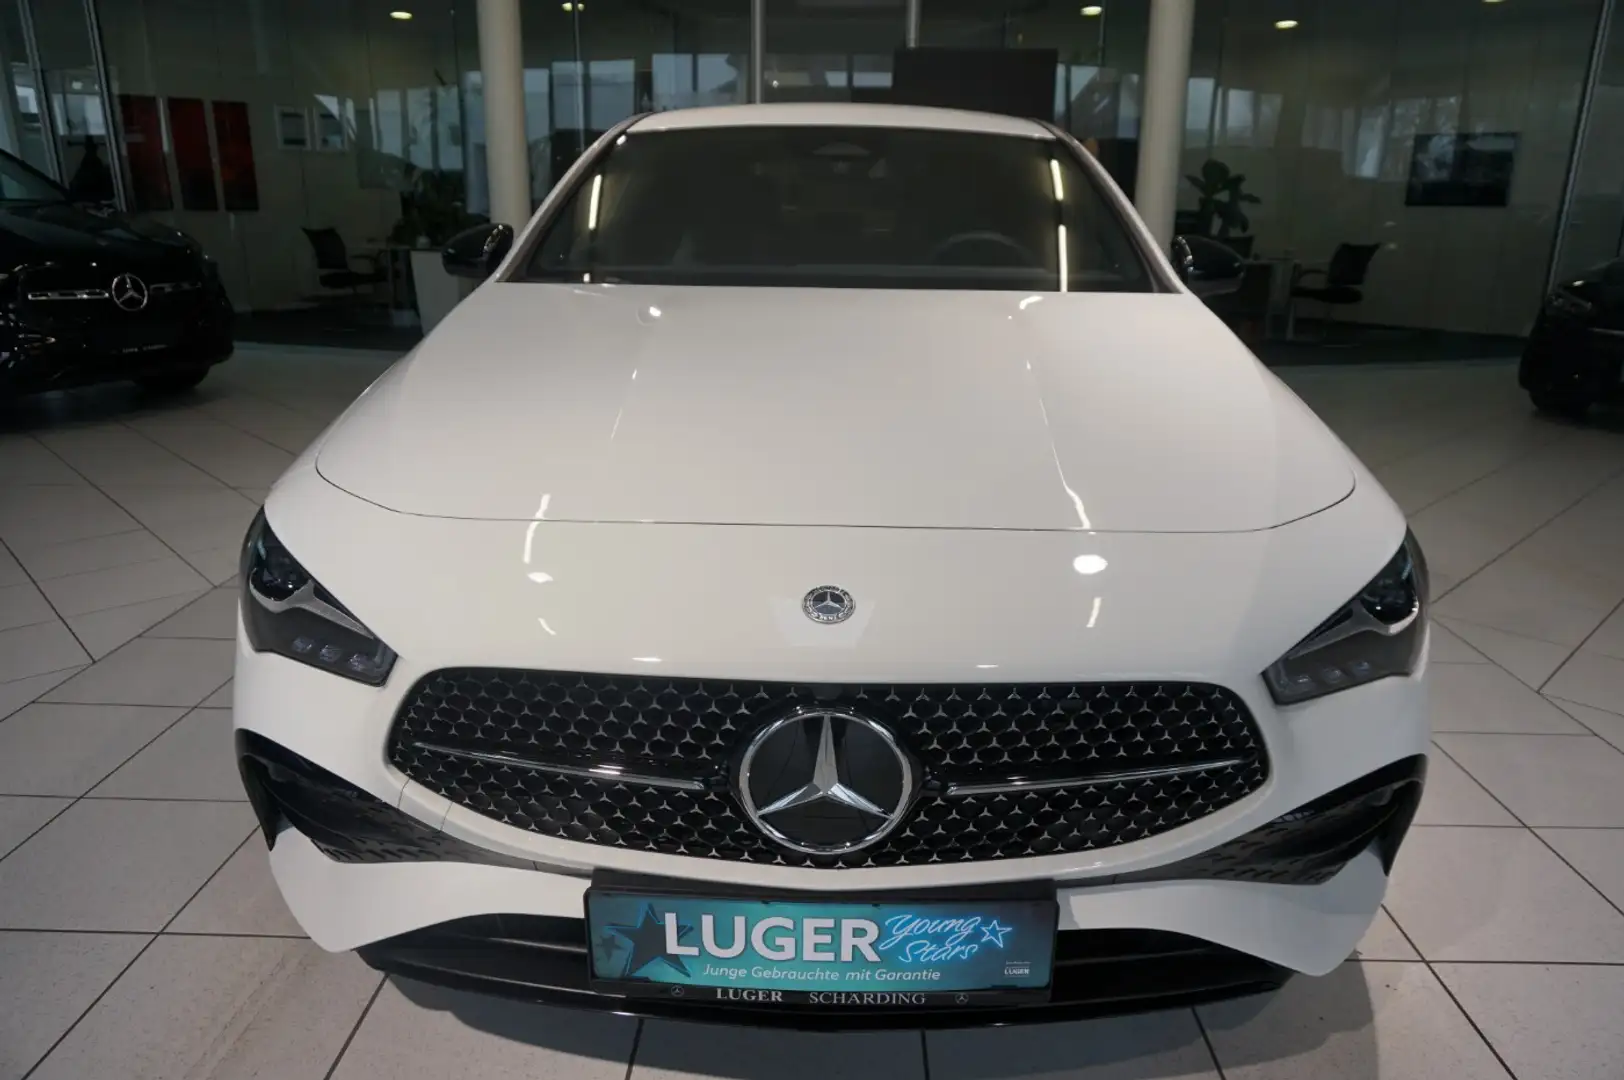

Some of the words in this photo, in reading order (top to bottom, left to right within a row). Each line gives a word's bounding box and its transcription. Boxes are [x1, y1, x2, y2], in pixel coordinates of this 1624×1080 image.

[664, 912, 881, 962] LUGER
[879, 914, 981, 950] Young
[898, 940, 978, 962] Stars
[703, 963, 748, 980] Junge
[751, 966, 840, 981] Gebrauchte
[845, 968, 872, 981] mit
[875, 968, 941, 981] Garantie
[716, 984, 784, 1002] LUGER
